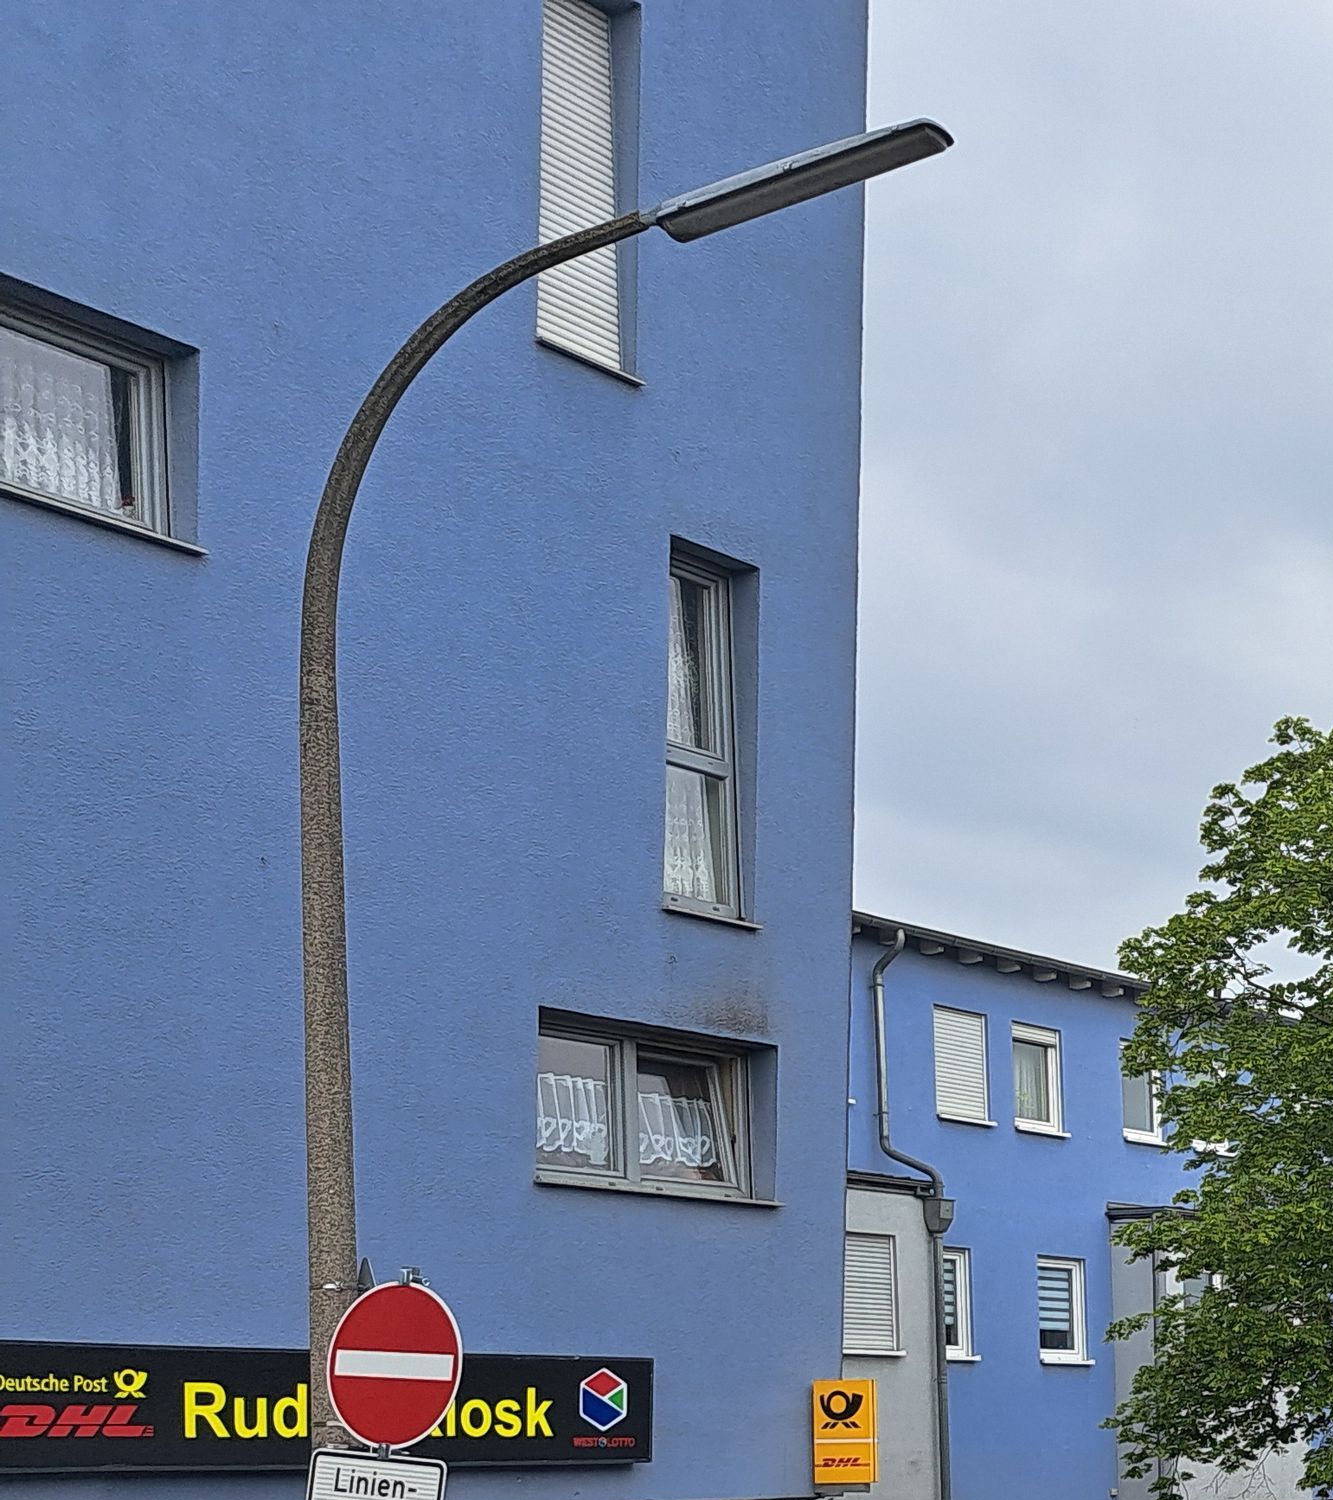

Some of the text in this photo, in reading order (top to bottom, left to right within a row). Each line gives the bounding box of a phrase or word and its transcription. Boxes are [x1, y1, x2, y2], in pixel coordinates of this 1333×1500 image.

[0, 1373, 108, 1392] Deutsche Post
[0, 1404, 154, 1438] DHL
[183, 1381, 554, 1439] Rud iosk
[816, 1457, 869, 1468] DHL
[333, 1467, 418, 1499] Linien-
